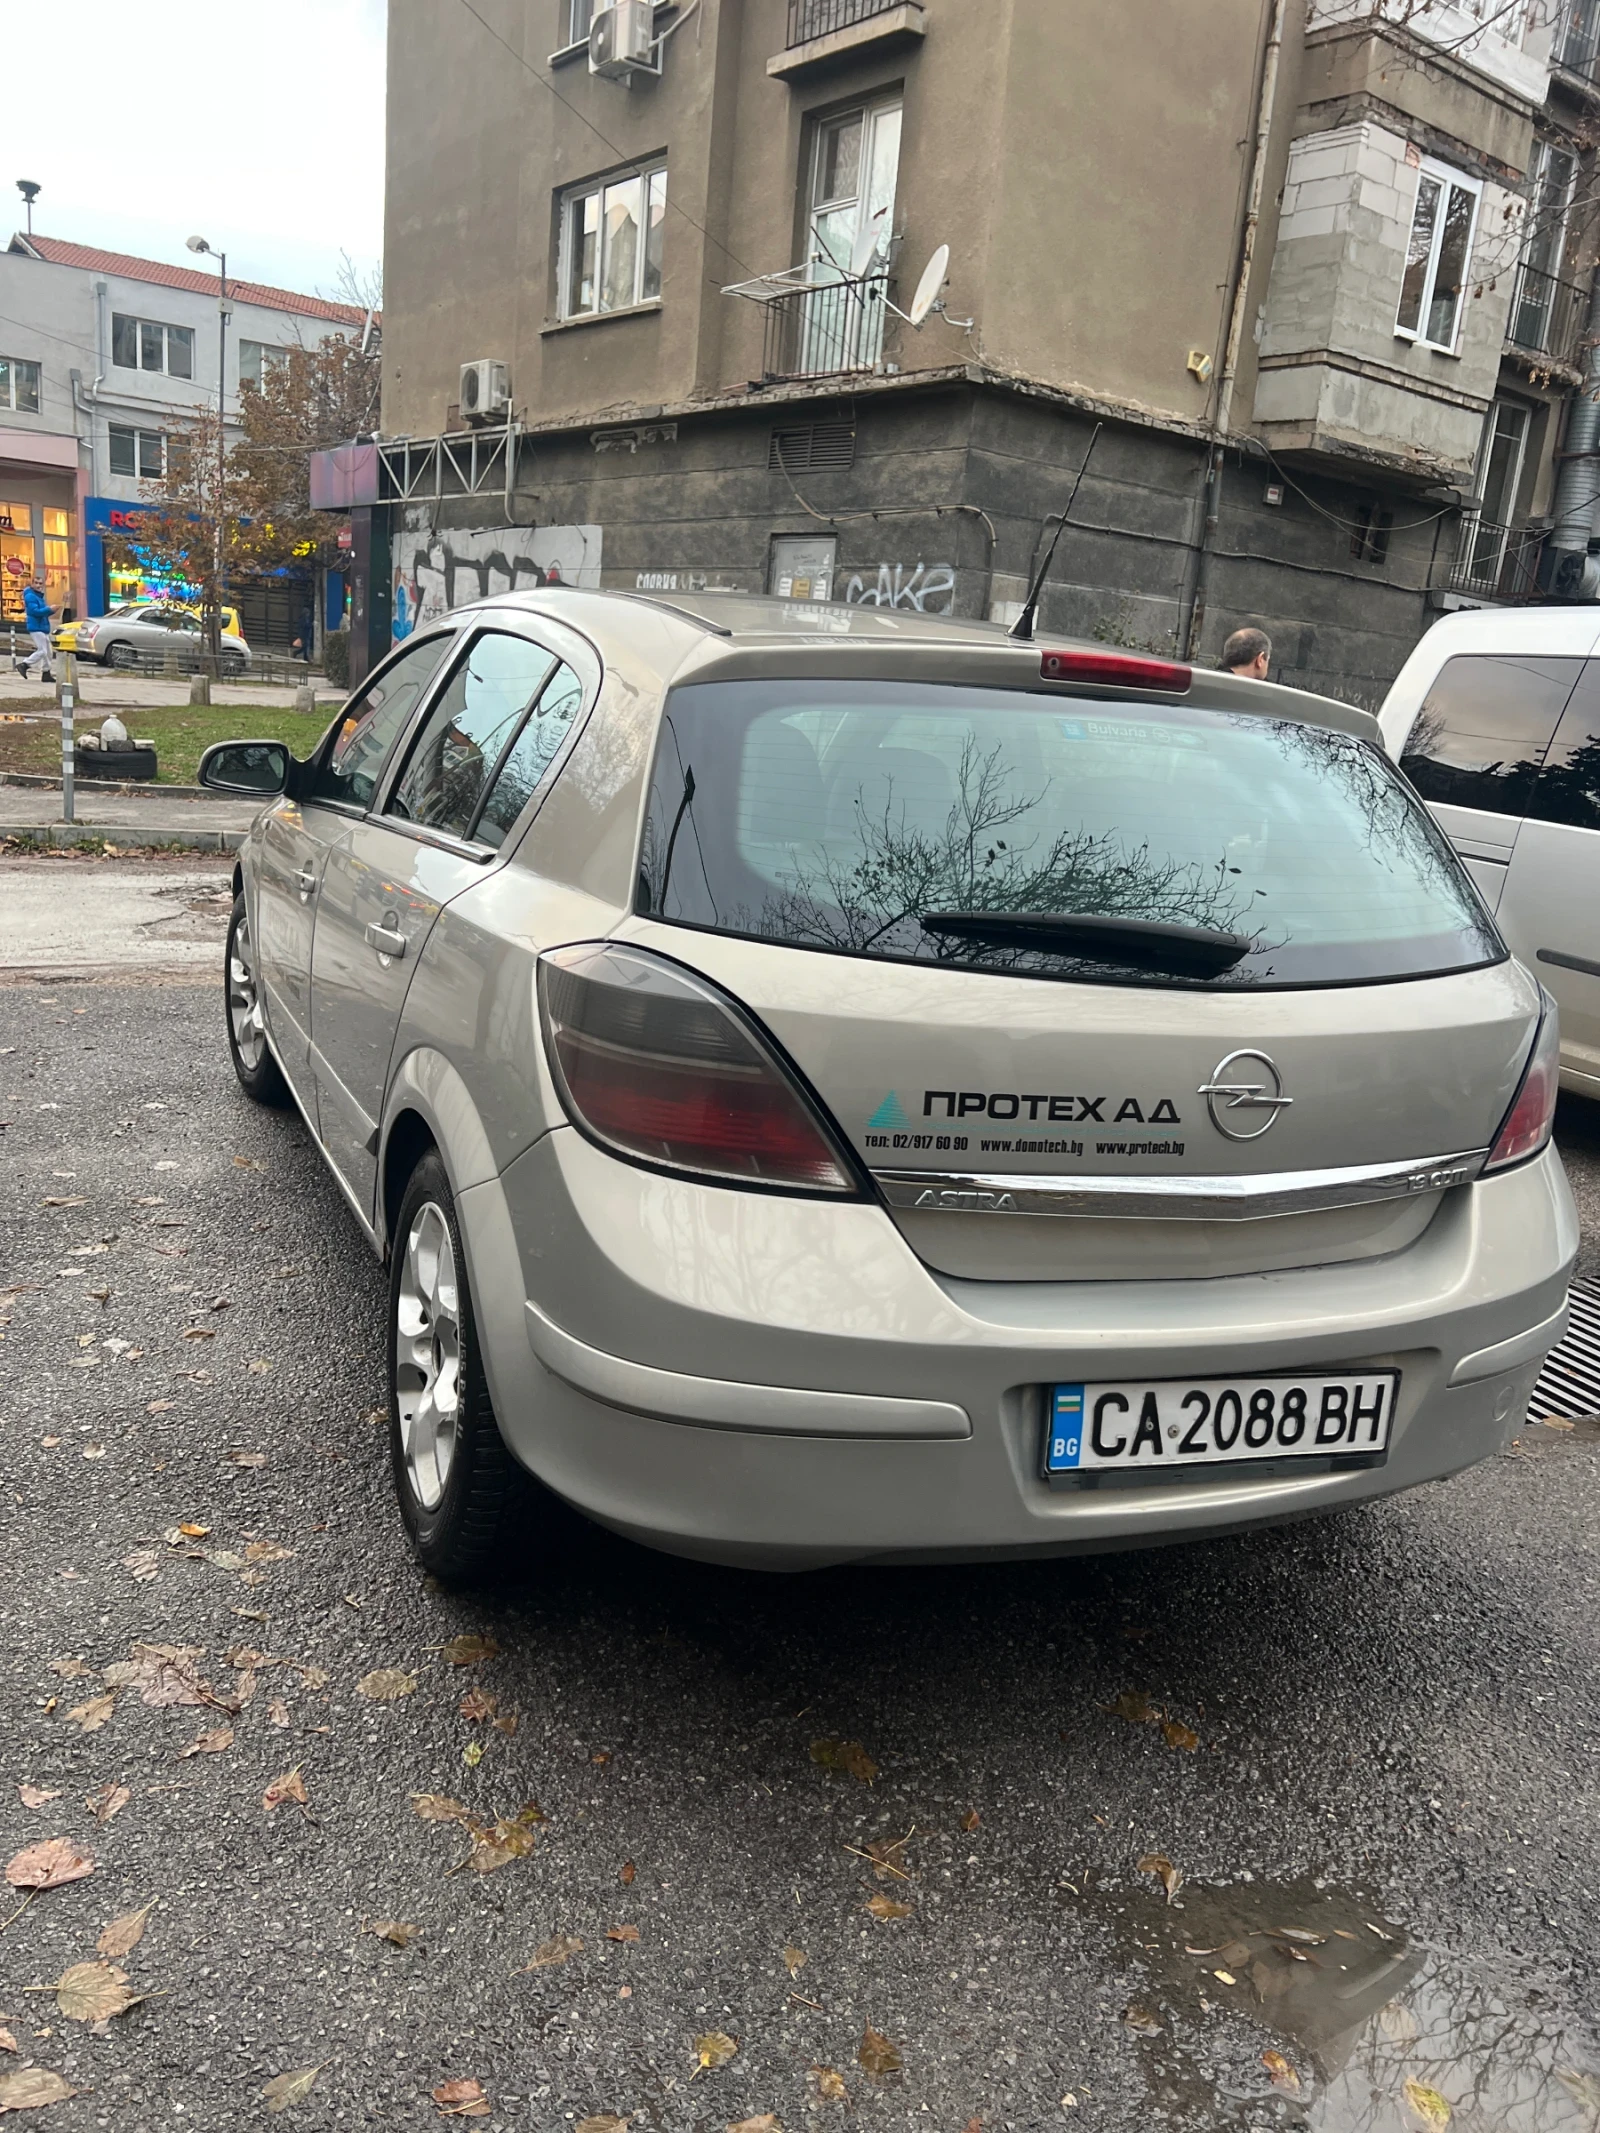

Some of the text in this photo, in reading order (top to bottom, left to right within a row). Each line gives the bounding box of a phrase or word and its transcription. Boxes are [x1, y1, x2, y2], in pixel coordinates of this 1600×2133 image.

[1087, 721, 1147, 738] Bulvaria
[923, 1091, 1181, 1123] ПРОТЕХ АД
[865, 1134, 1185, 1157] тел: 02/917 60 90 www.domotech.bg www.protech.bg
[914, 1189, 1019, 1211] ASTRA
[1091, 1383, 1386, 1458] CA 2088 BH
[1053, 1437, 1078, 1458] BG
